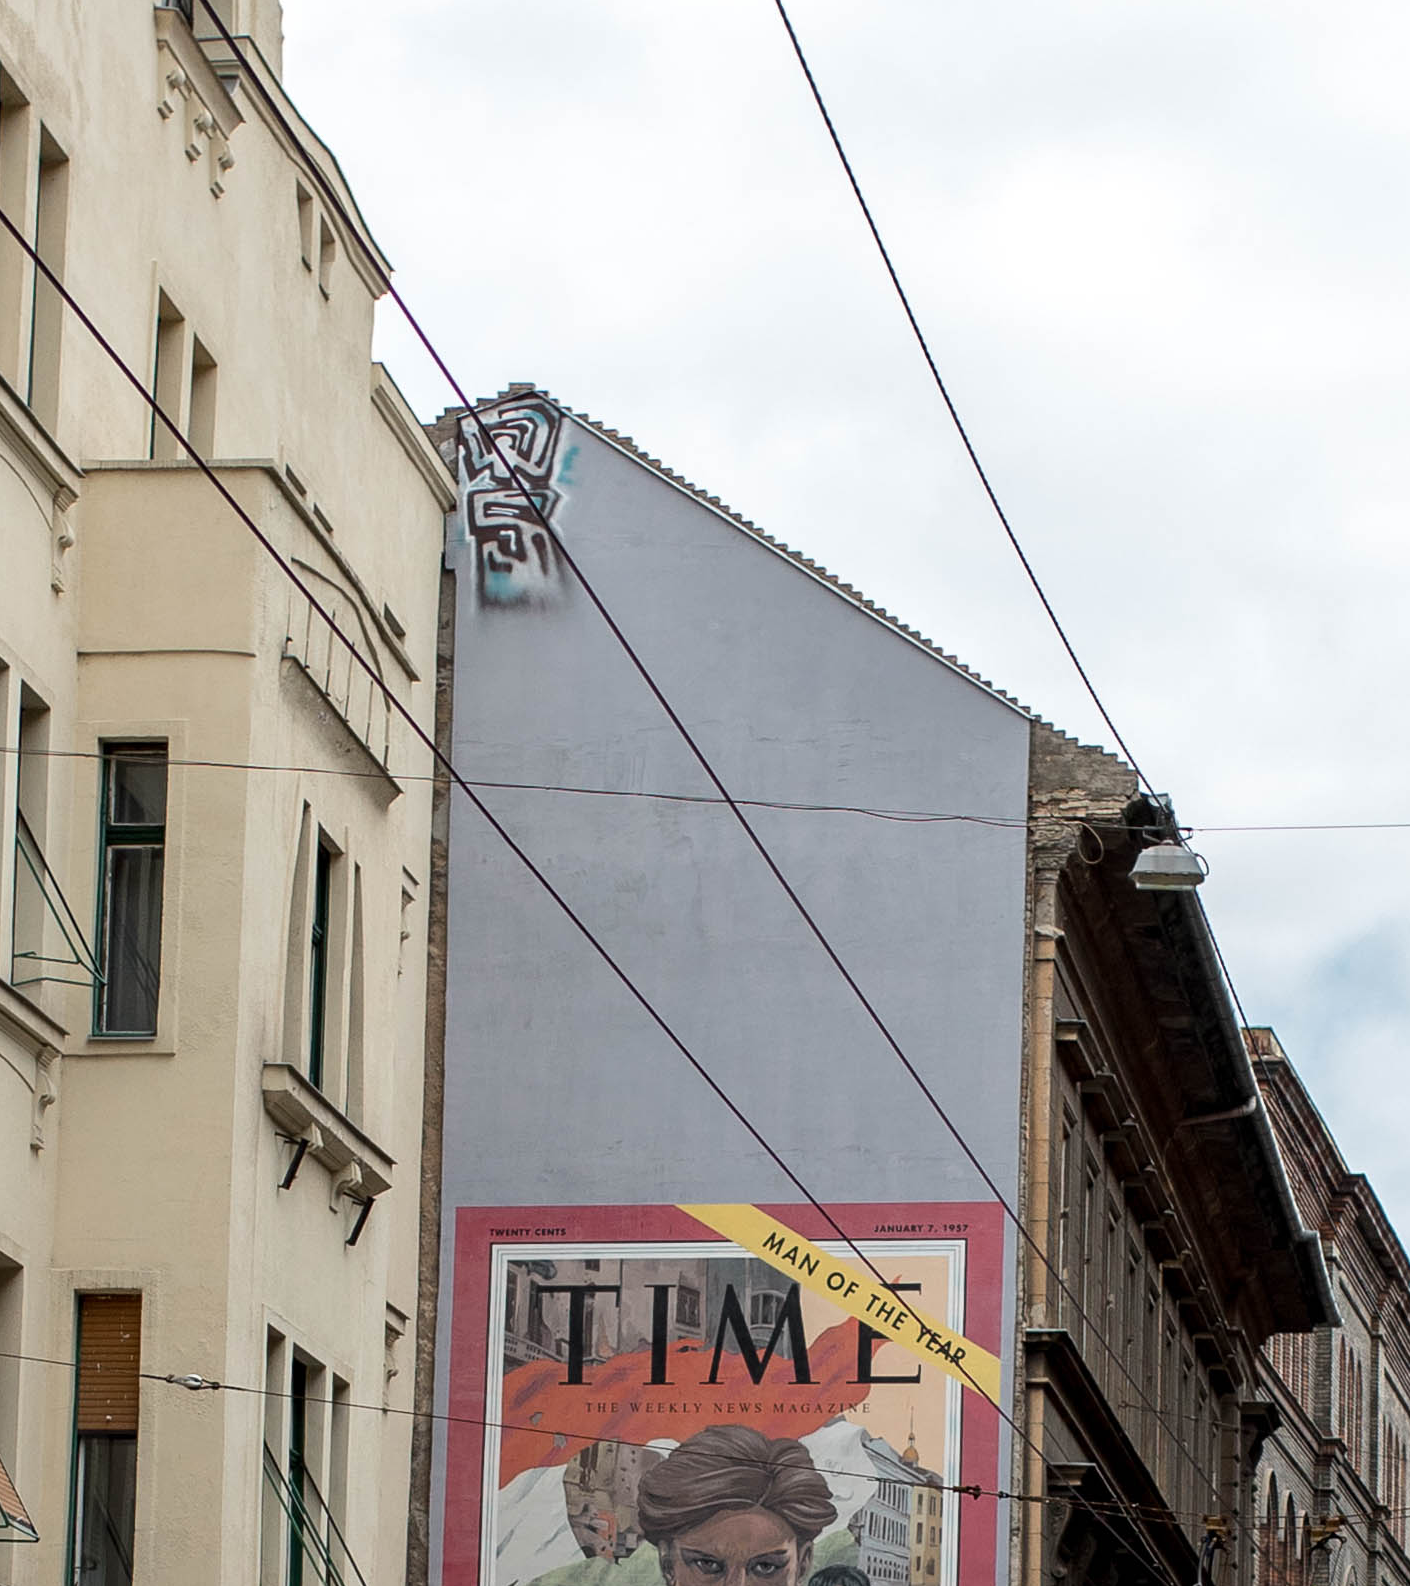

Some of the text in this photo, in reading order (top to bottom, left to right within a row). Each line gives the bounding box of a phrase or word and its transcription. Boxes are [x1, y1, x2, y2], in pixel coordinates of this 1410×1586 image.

[489, 1227, 567, 1237] TWENTY CENTS
[873, 1223, 969, 1234] JANUARY 7, 1957
[762, 1231, 967, 1365] MAN OF THE YEAR
[536, 1281, 922, 1386] TIME
[585, 1402, 871, 1414] THE WEEKLY NEWS MAGAZINE
